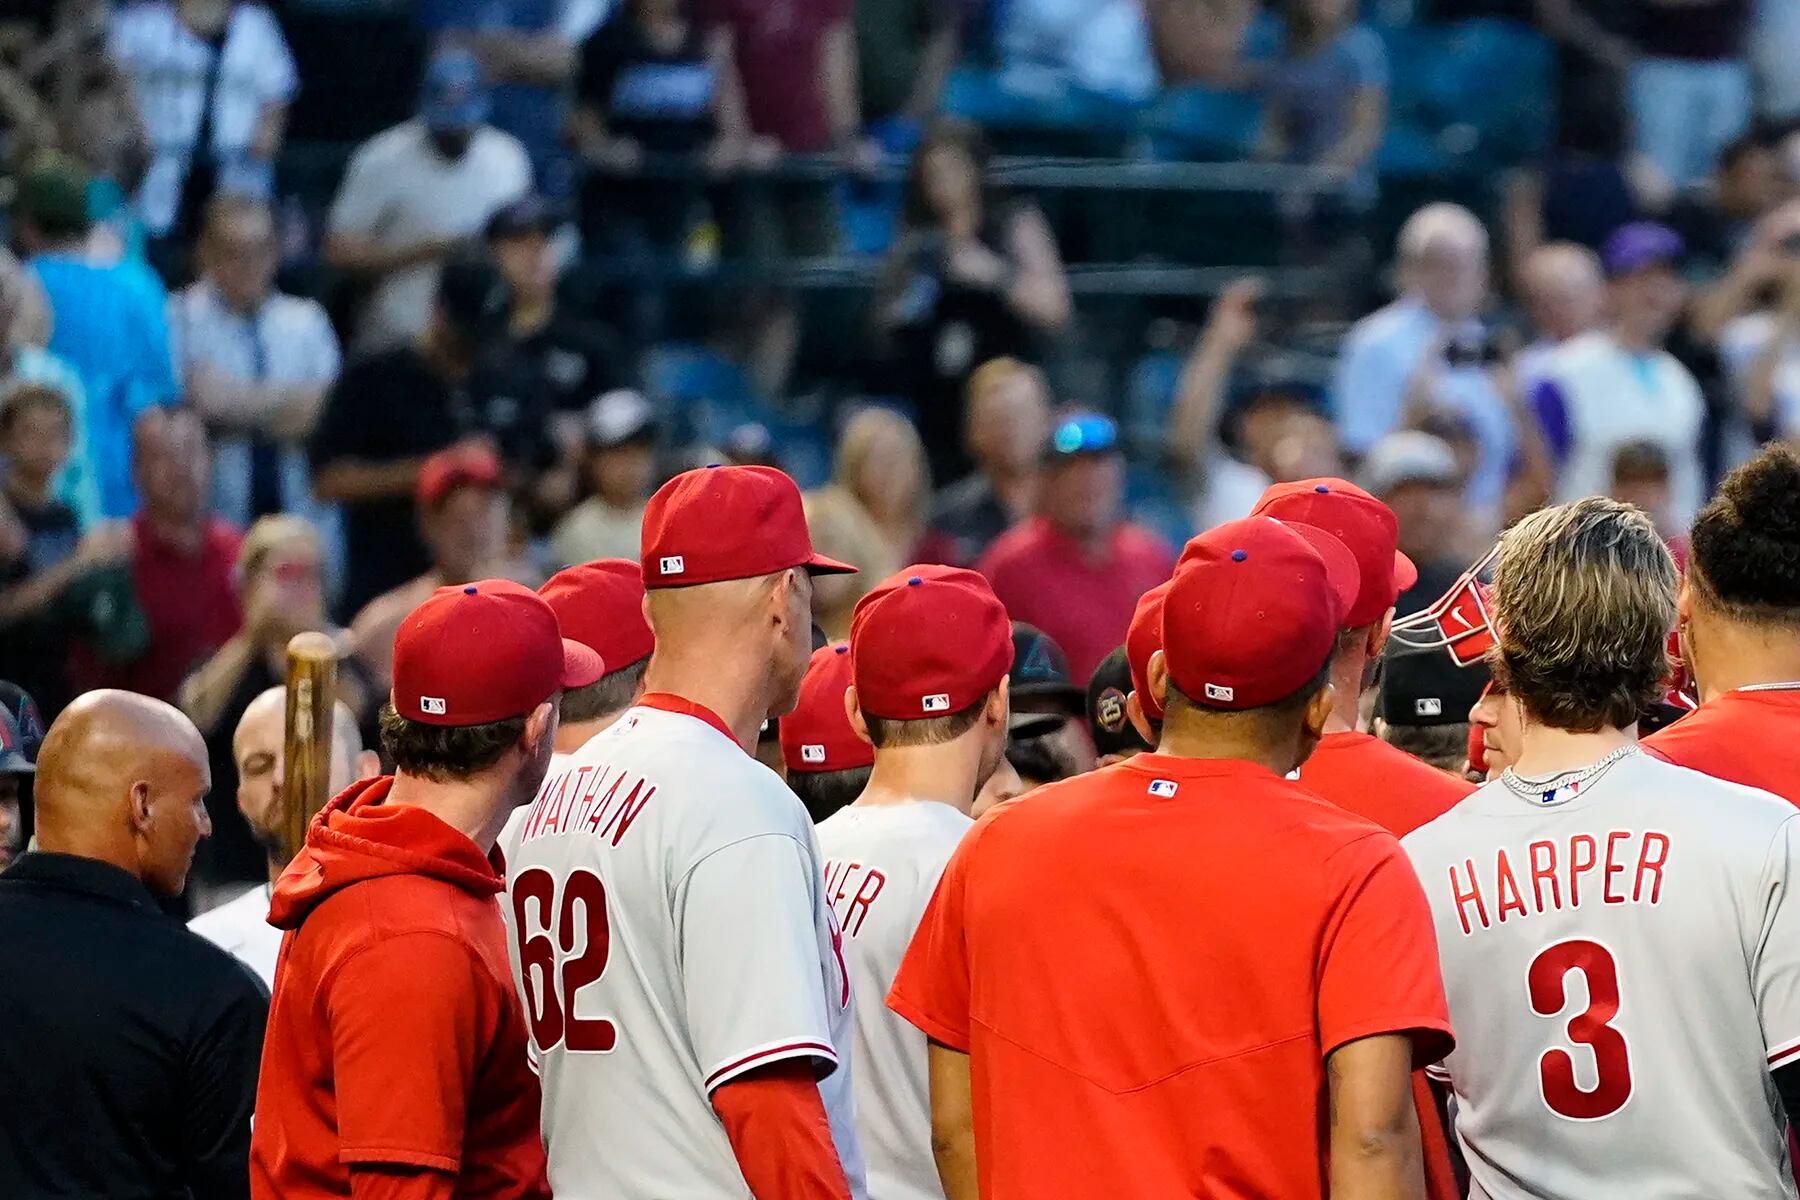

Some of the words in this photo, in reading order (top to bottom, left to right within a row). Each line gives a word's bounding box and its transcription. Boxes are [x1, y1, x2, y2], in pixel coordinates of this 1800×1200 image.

[511, 866, 618, 1055] 62
[1447, 829, 1672, 936] HARPER
[1526, 936, 1634, 1122] 3
